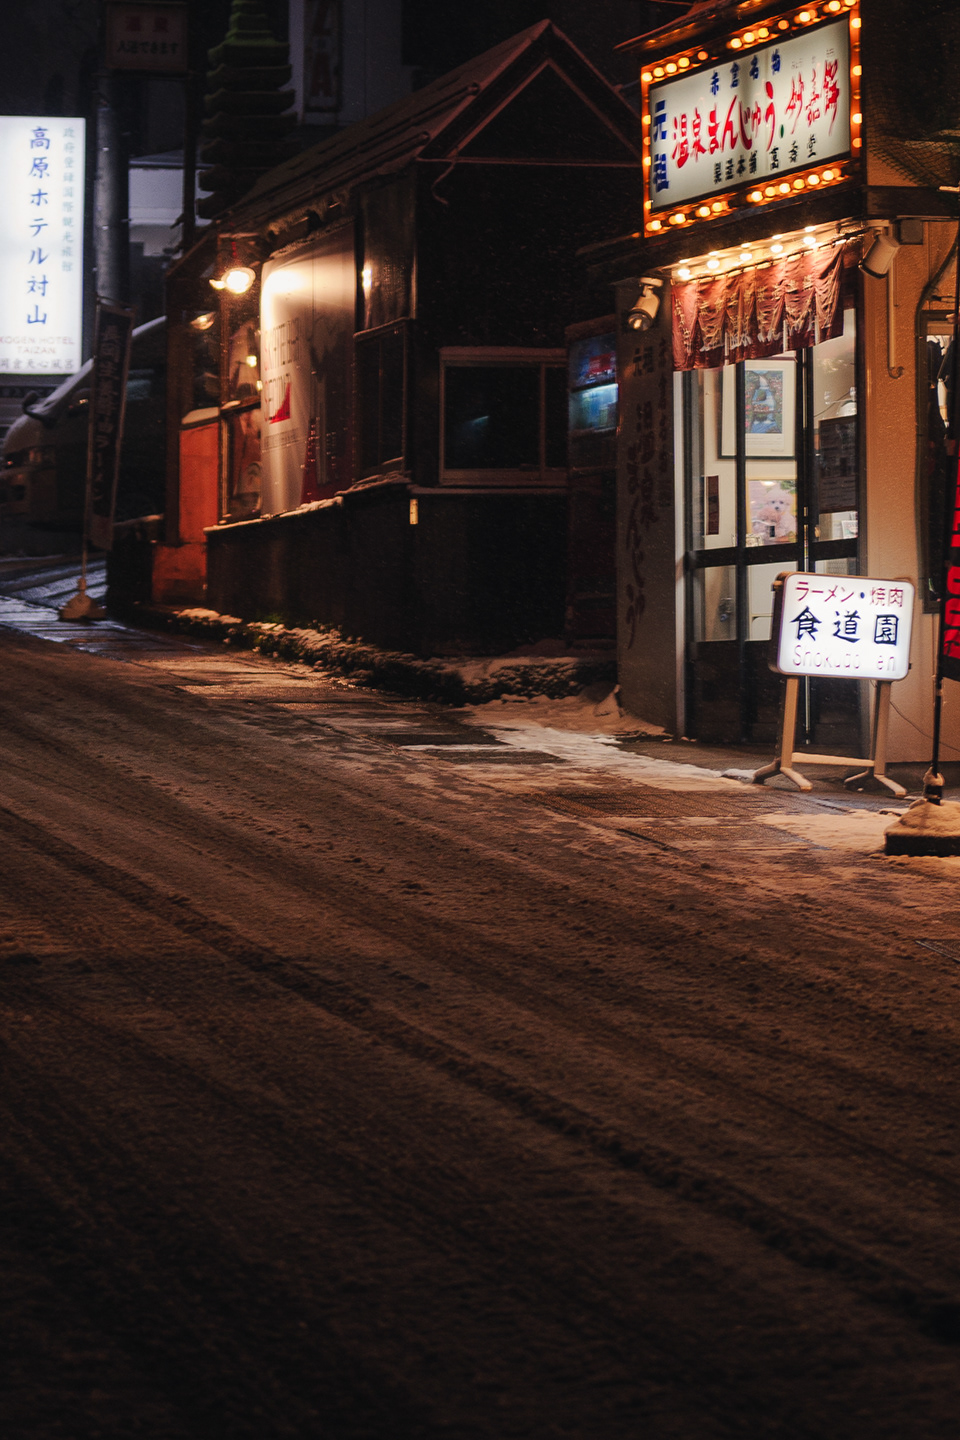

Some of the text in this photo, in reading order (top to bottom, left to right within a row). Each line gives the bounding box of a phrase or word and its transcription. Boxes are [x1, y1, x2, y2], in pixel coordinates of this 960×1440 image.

[652, 100, 671, 193] 元祖
[26, 126, 51, 325] 高原ホテル対山
[17, 346, 56, 354] TAIZAN
[39, 335, 75, 345] HOTEL
[789, 605, 900, 647] 食道園
